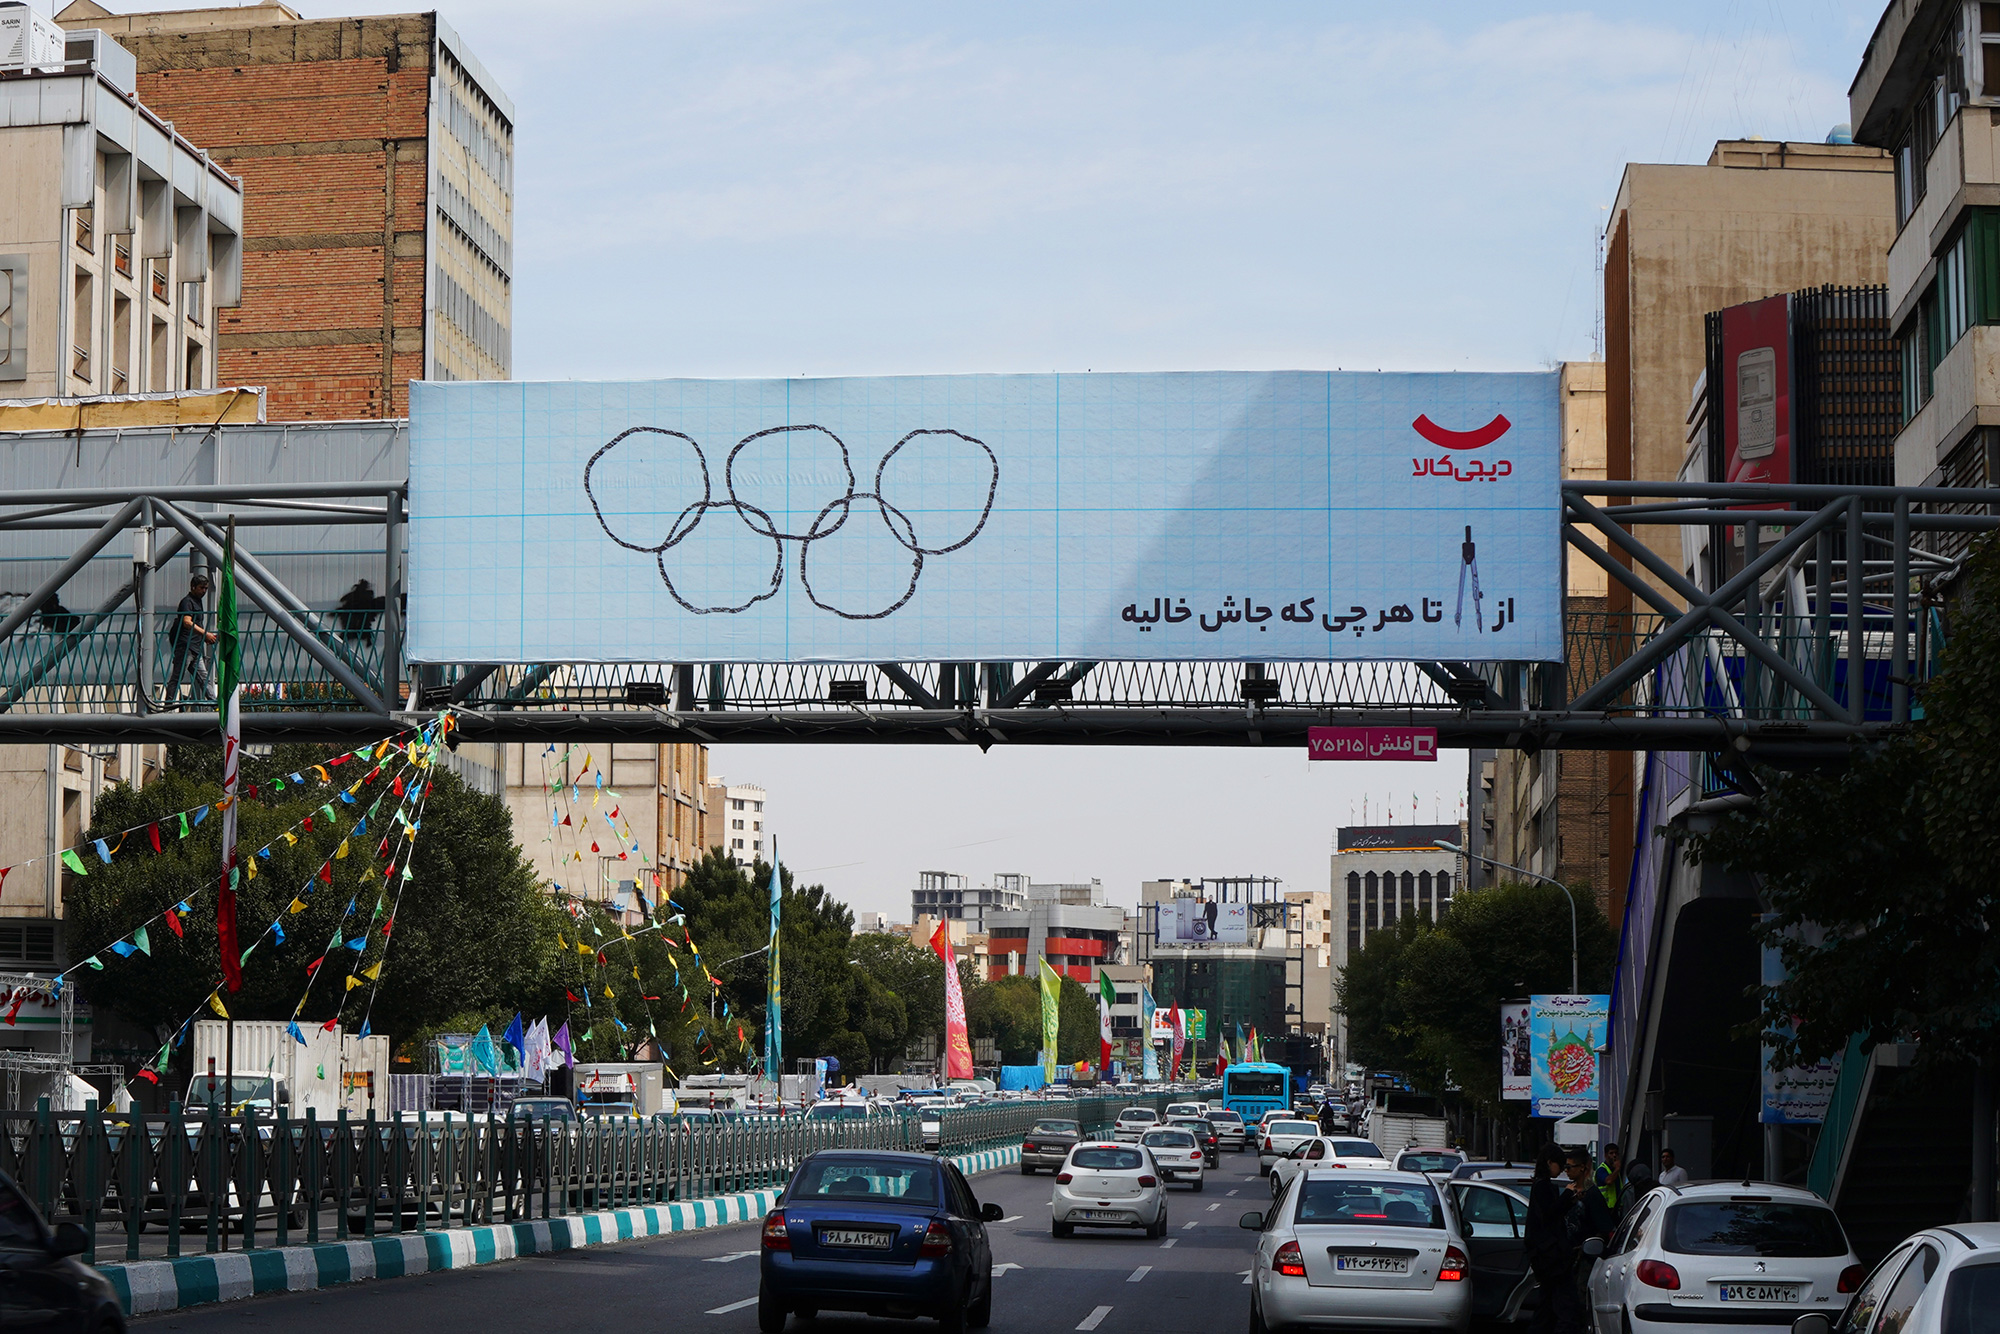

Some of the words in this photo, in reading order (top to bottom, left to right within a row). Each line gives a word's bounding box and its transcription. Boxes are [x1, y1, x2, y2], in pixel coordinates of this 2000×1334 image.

[1121, 597, 1192, 633] خالیه
[1199, 595, 1273, 632] جاش
[1280, 596, 1315, 623] که
[1422, 597, 1443, 623] تا
[1491, 597, 1515, 633] از
[1311, 739, 1365, 752] ۷۵۲۱۵
[1370, 734, 1412, 756] فلش
[1551, 996, 1570, 1007] بزرگ
[1569, 996, 1591, 1007] جشن
[1774, 1075, 1818, 1090] مهربانی
[1818, 1079, 1824, 1090] و
[828, 1231, 841, 1243] ۶۸
[875, 1236, 888, 1246] ۸۸
[1358, 1259, 1370, 1268] س
[1728, 1286, 1744, 1299] ۵۹
[1745, 1286, 1756, 1299] ج
[1758, 1287, 1781, 1300] ۵۸۲
[1783, 1290, 1797, 1301] ۲۰
